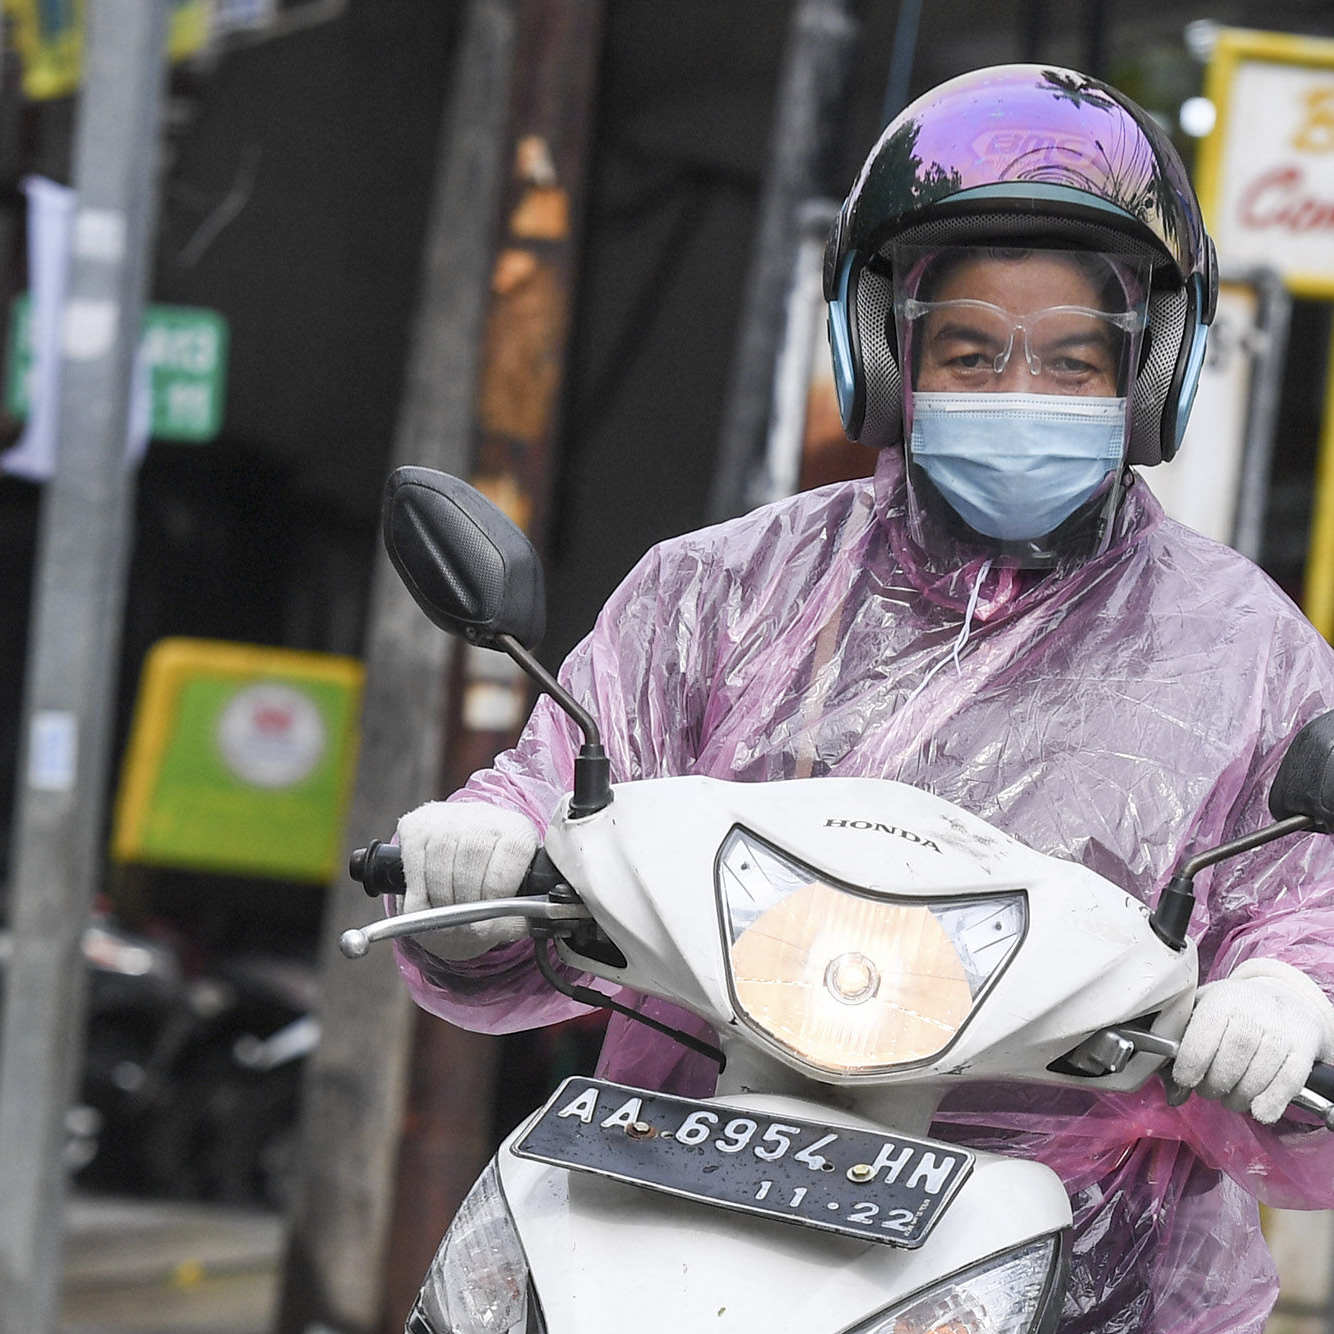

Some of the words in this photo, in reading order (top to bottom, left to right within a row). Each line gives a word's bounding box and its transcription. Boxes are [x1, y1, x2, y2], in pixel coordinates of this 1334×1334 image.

[823, 817, 944, 855] HONDA
[557, 1087, 643, 1130] AA
[675, 1110, 839, 1171] 6954
[869, 1142, 957, 1195] HN
